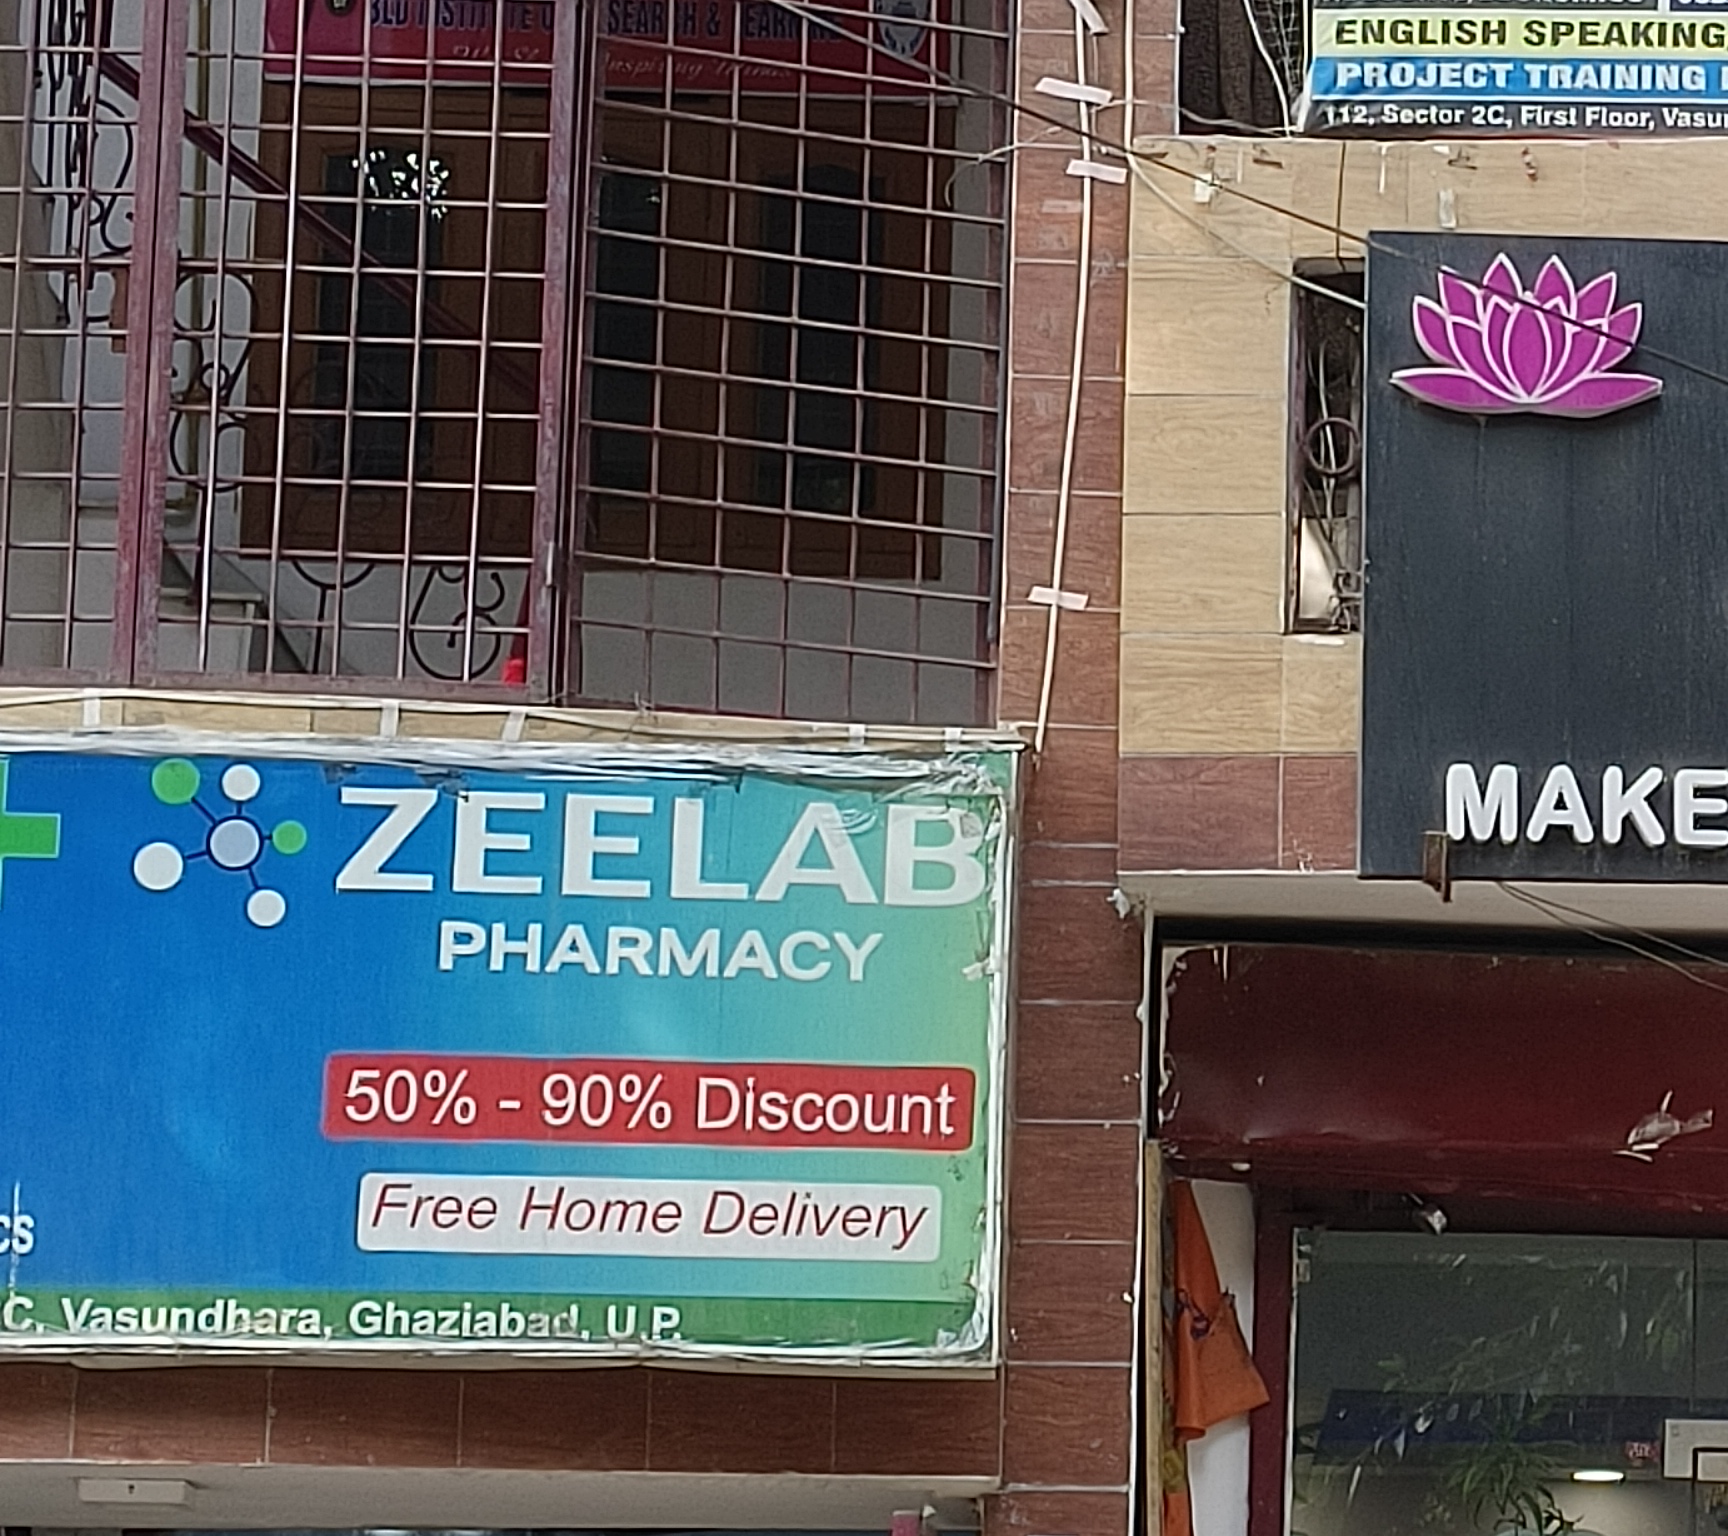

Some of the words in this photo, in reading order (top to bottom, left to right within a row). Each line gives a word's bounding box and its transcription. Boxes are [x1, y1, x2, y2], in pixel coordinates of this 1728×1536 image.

[1334, 18, 1508, 47] ENGLISH
[1334, 61, 1514, 91] PROJECT
[1525, 62, 1708, 93] TRAINING
[1381, 103, 1465, 126] Sector
[1471, 105, 1513, 131] 2C,
[1519, 104, 1577, 128] First
[1583, 105, 1657, 131] Floor,
[335, 786, 987, 911] ZEELAB
[436, 919, 884, 983] PHARMACY
[343, 1067, 478, 1127] 50%
[541, 1071, 673, 1131] 90%
[695, 1076, 956, 1136] Discount
[370, 1182, 499, 1230] Free
[517, 1185, 684, 1234] Home
[701, 1189, 929, 1251] Delivery
[61, 1297, 334, 1340] Vasundhara,
